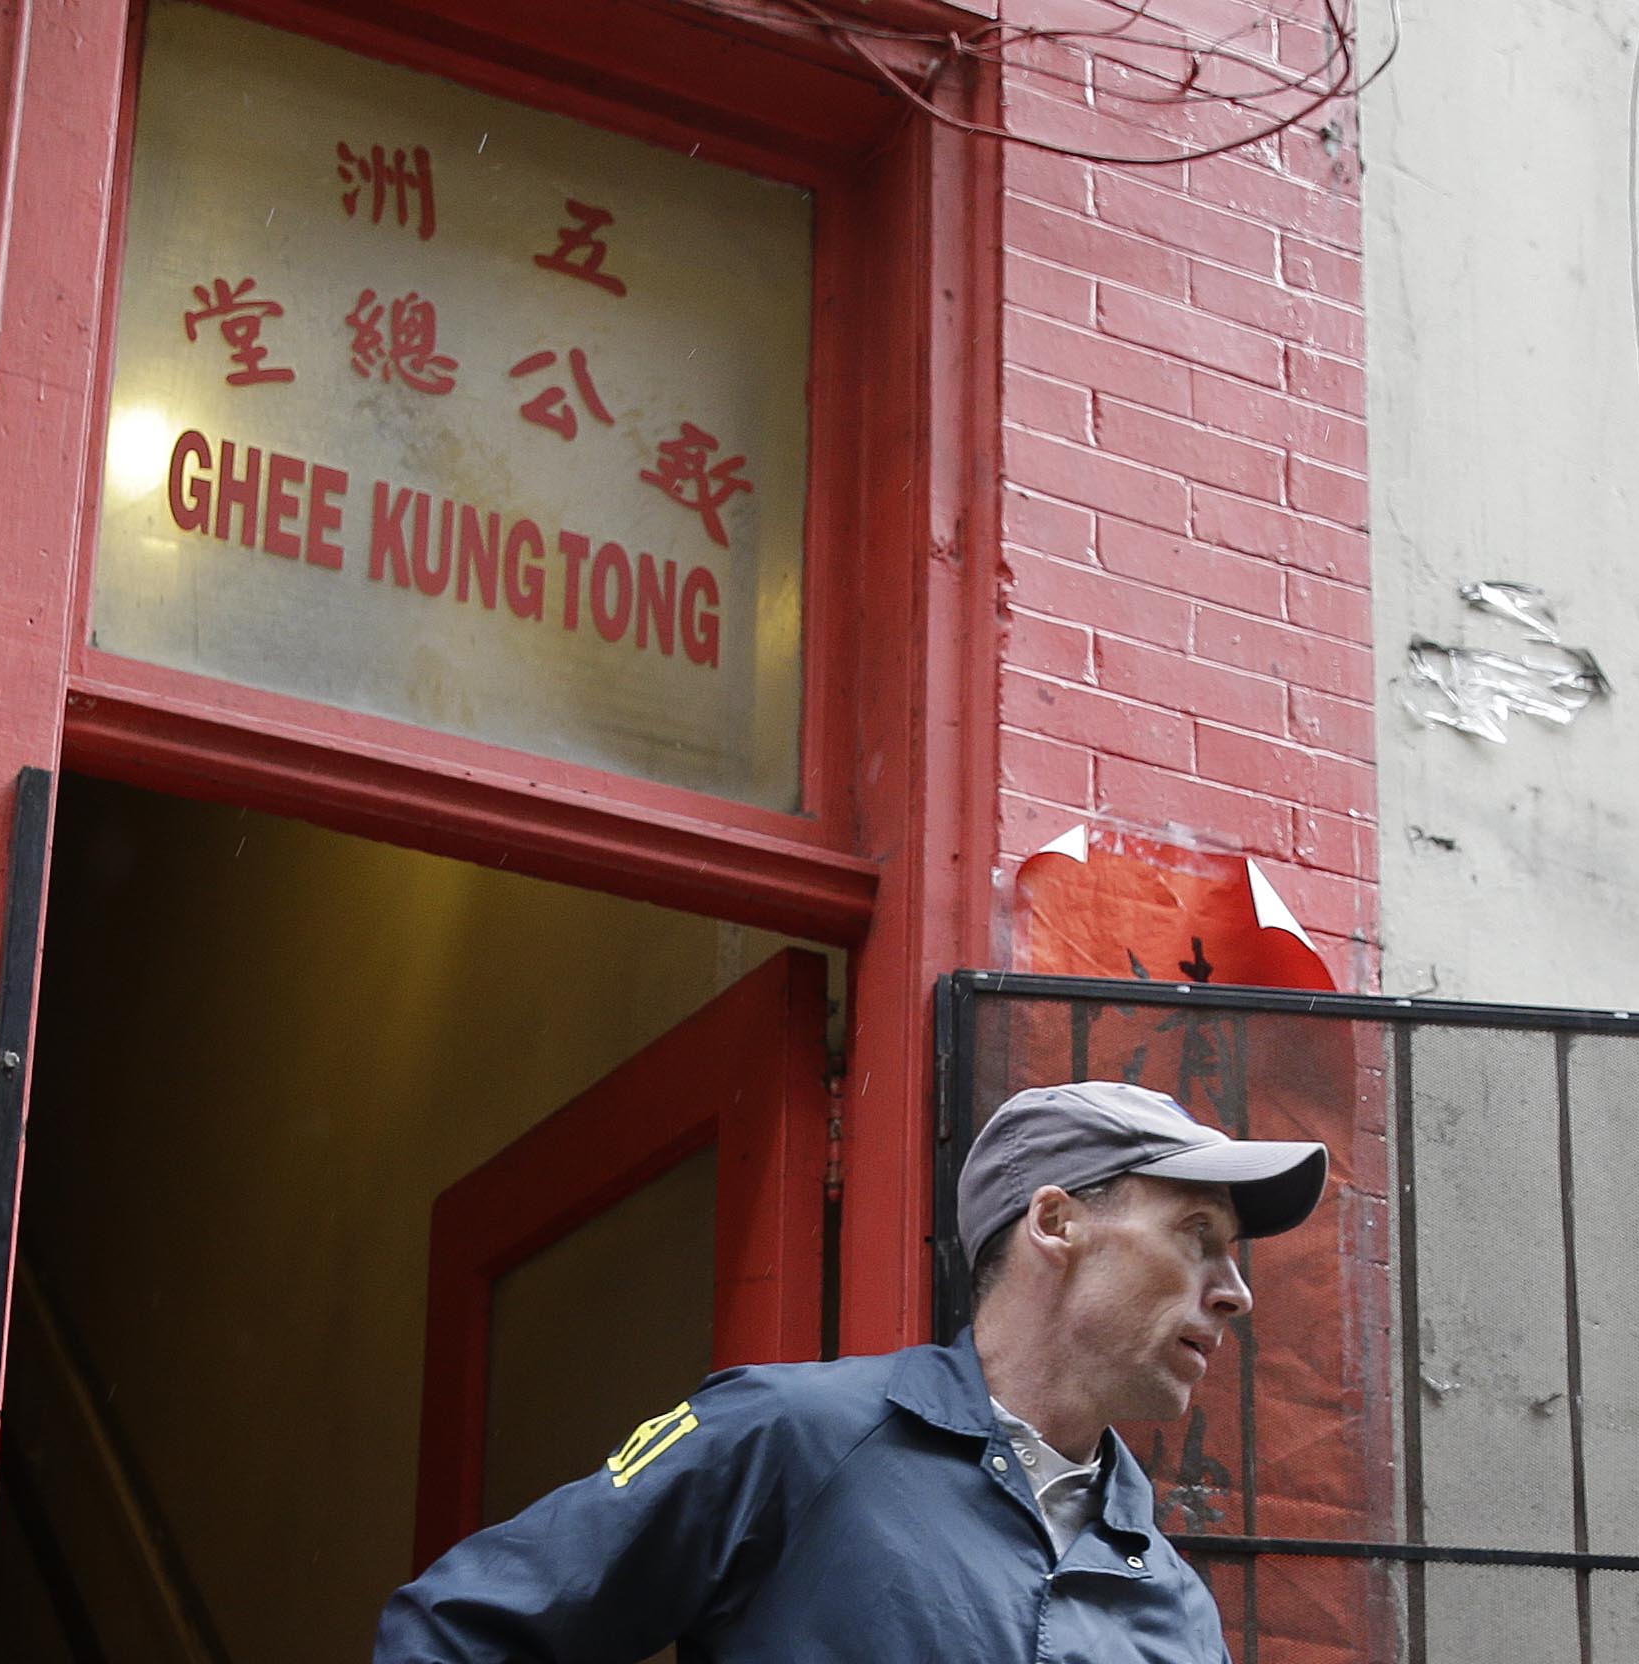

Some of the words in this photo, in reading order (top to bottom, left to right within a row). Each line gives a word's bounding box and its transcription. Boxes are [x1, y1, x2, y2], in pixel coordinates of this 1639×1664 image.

[167, 430, 349, 571] GHEE
[368, 480, 546, 623] KUNG
[557, 529, 721, 669] TONG
[606, 1400, 699, 1488] BI
